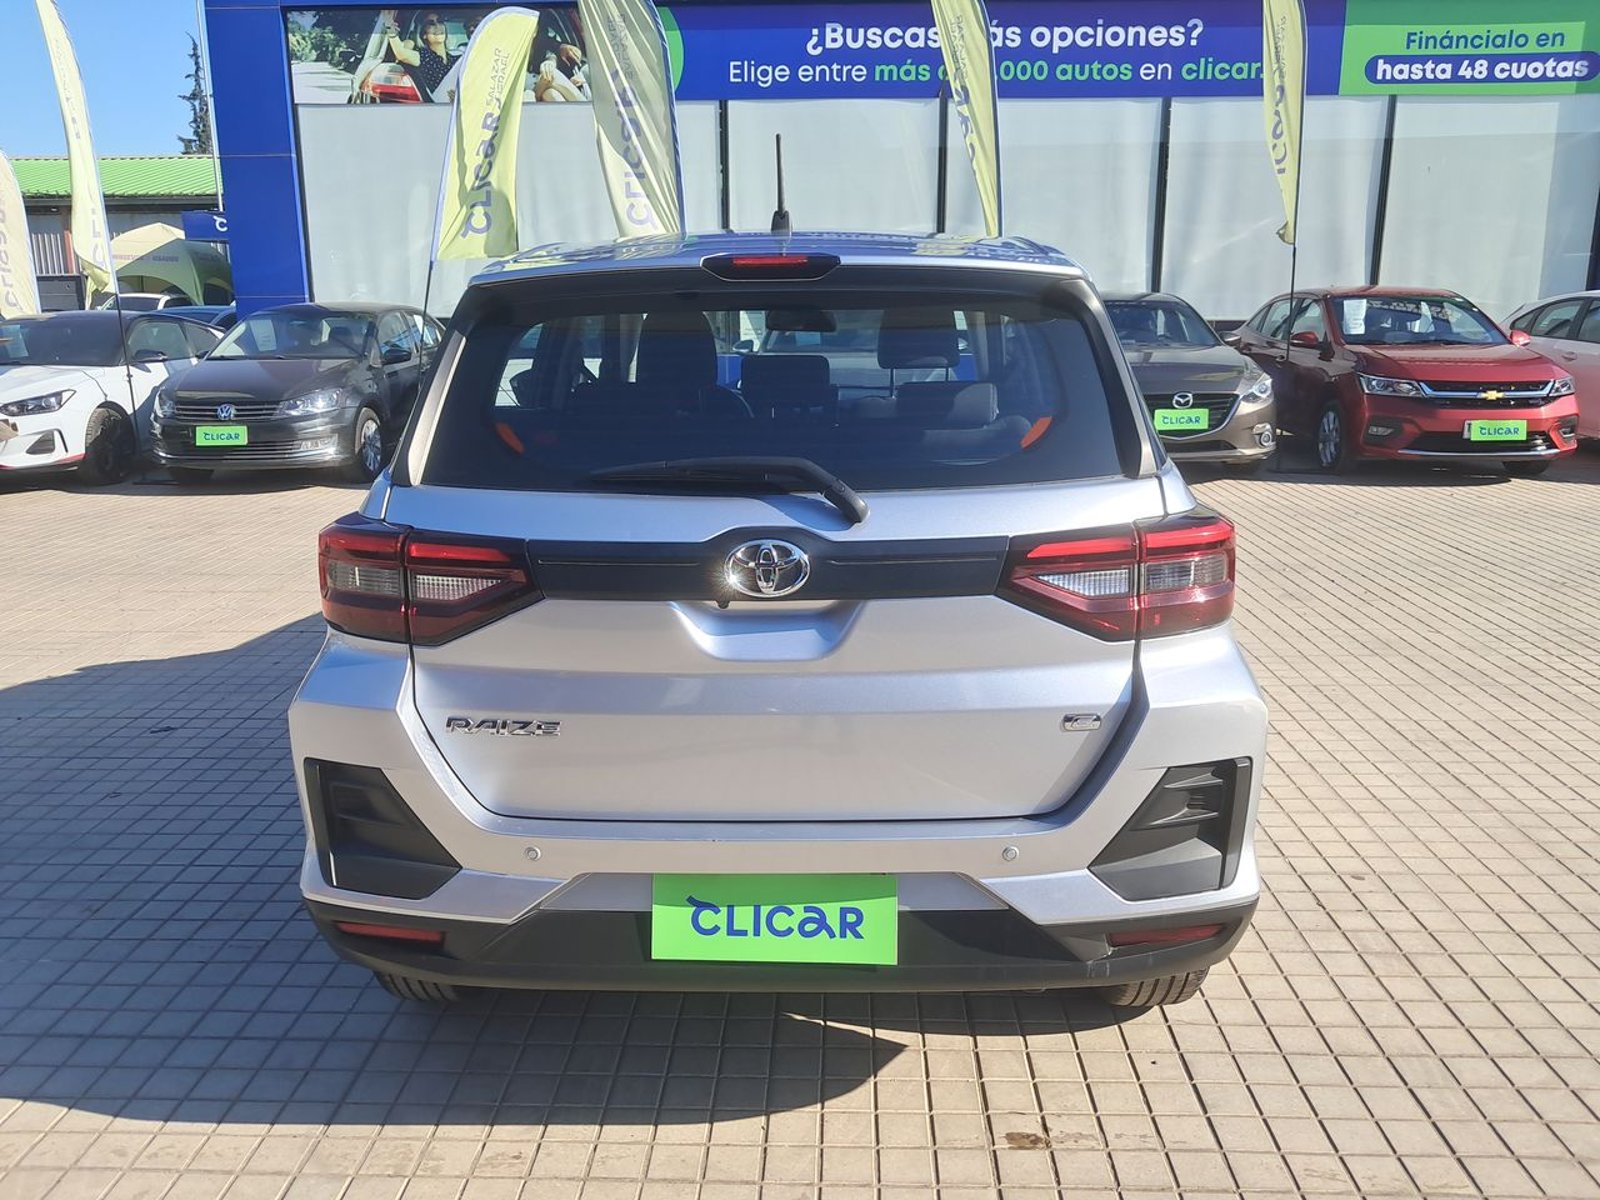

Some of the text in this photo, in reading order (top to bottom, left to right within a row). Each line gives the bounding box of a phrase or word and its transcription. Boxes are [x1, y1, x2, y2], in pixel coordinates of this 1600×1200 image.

[806, 22, 942, 56] ¿Buscas
[990, 20, 1021, 47] ás
[1030, 18, 1204, 54] opciones?
[1406, 30, 1565, 50] Fináncialo en
[729, 60, 790, 88] Elige
[798, 62, 867, 82] entre
[874, 59, 930, 81] más
[1055, 61, 1132, 81] autos
[1139, 63, 1172, 81] en
[1376, 58, 1589, 80] hasta 48 cuotas
[446, 716, 561, 736] RAIZE
